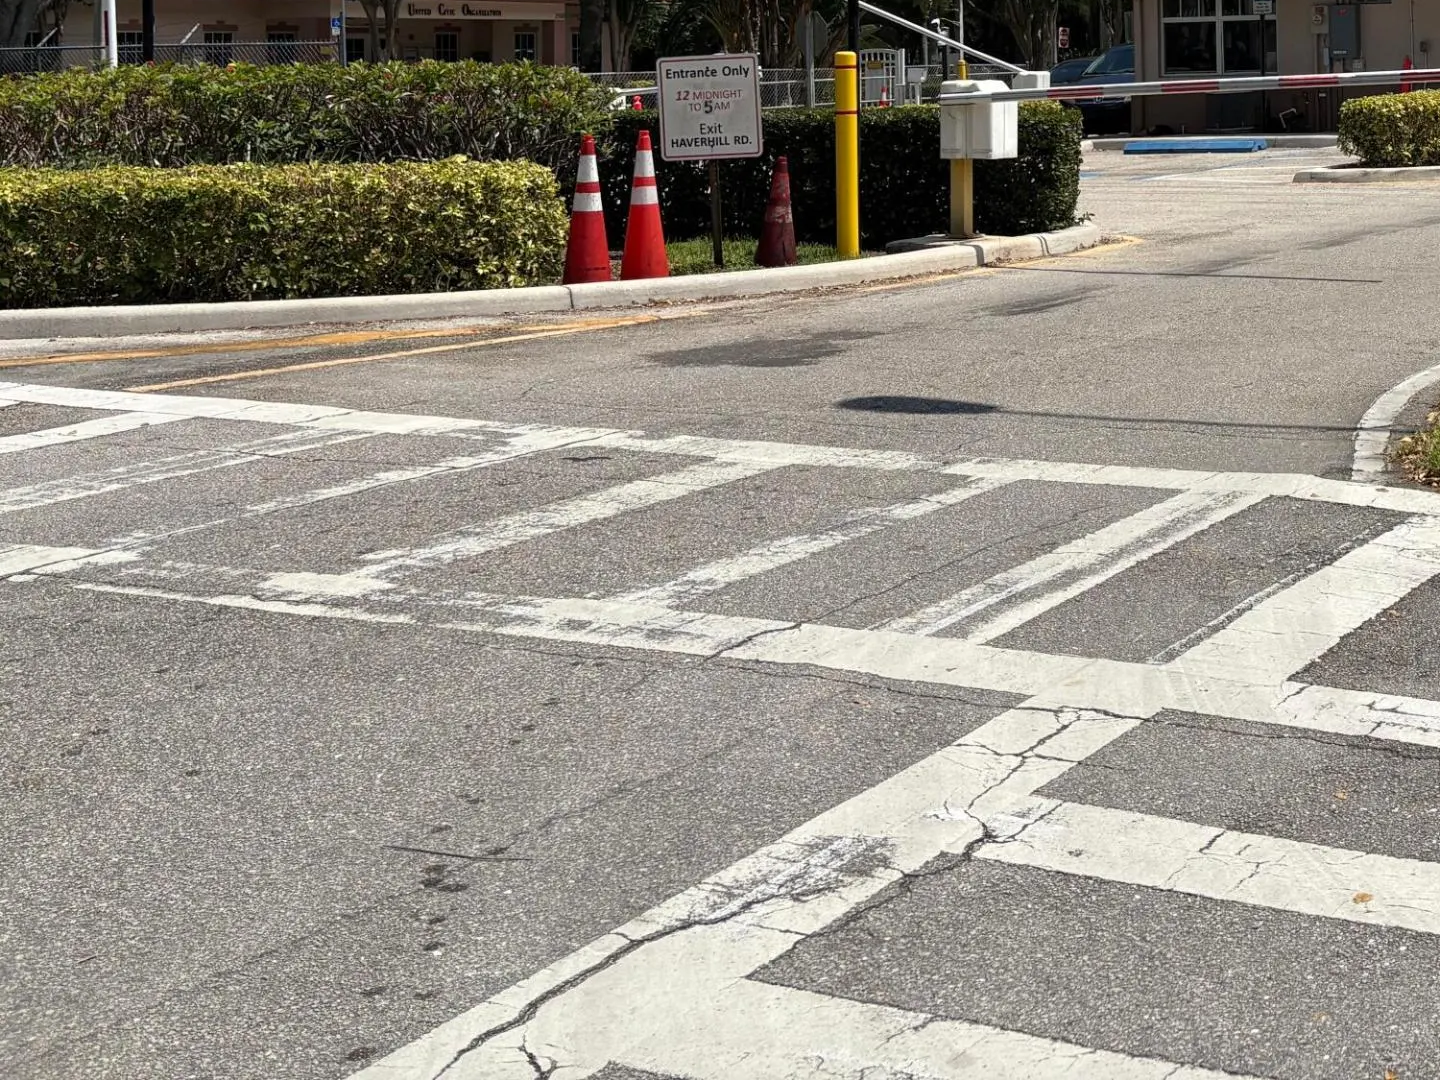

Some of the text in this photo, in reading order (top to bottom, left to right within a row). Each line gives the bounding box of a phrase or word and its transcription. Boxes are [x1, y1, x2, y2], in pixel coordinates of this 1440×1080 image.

[666, 65, 750, 79] Entrance Only
[676, 89, 742, 101] 12 MIDNIGHT
[689, 102, 702, 112] TO
[700, 123, 723, 135] Exit
[671, 135, 752, 148] HAVERHILL RD.
